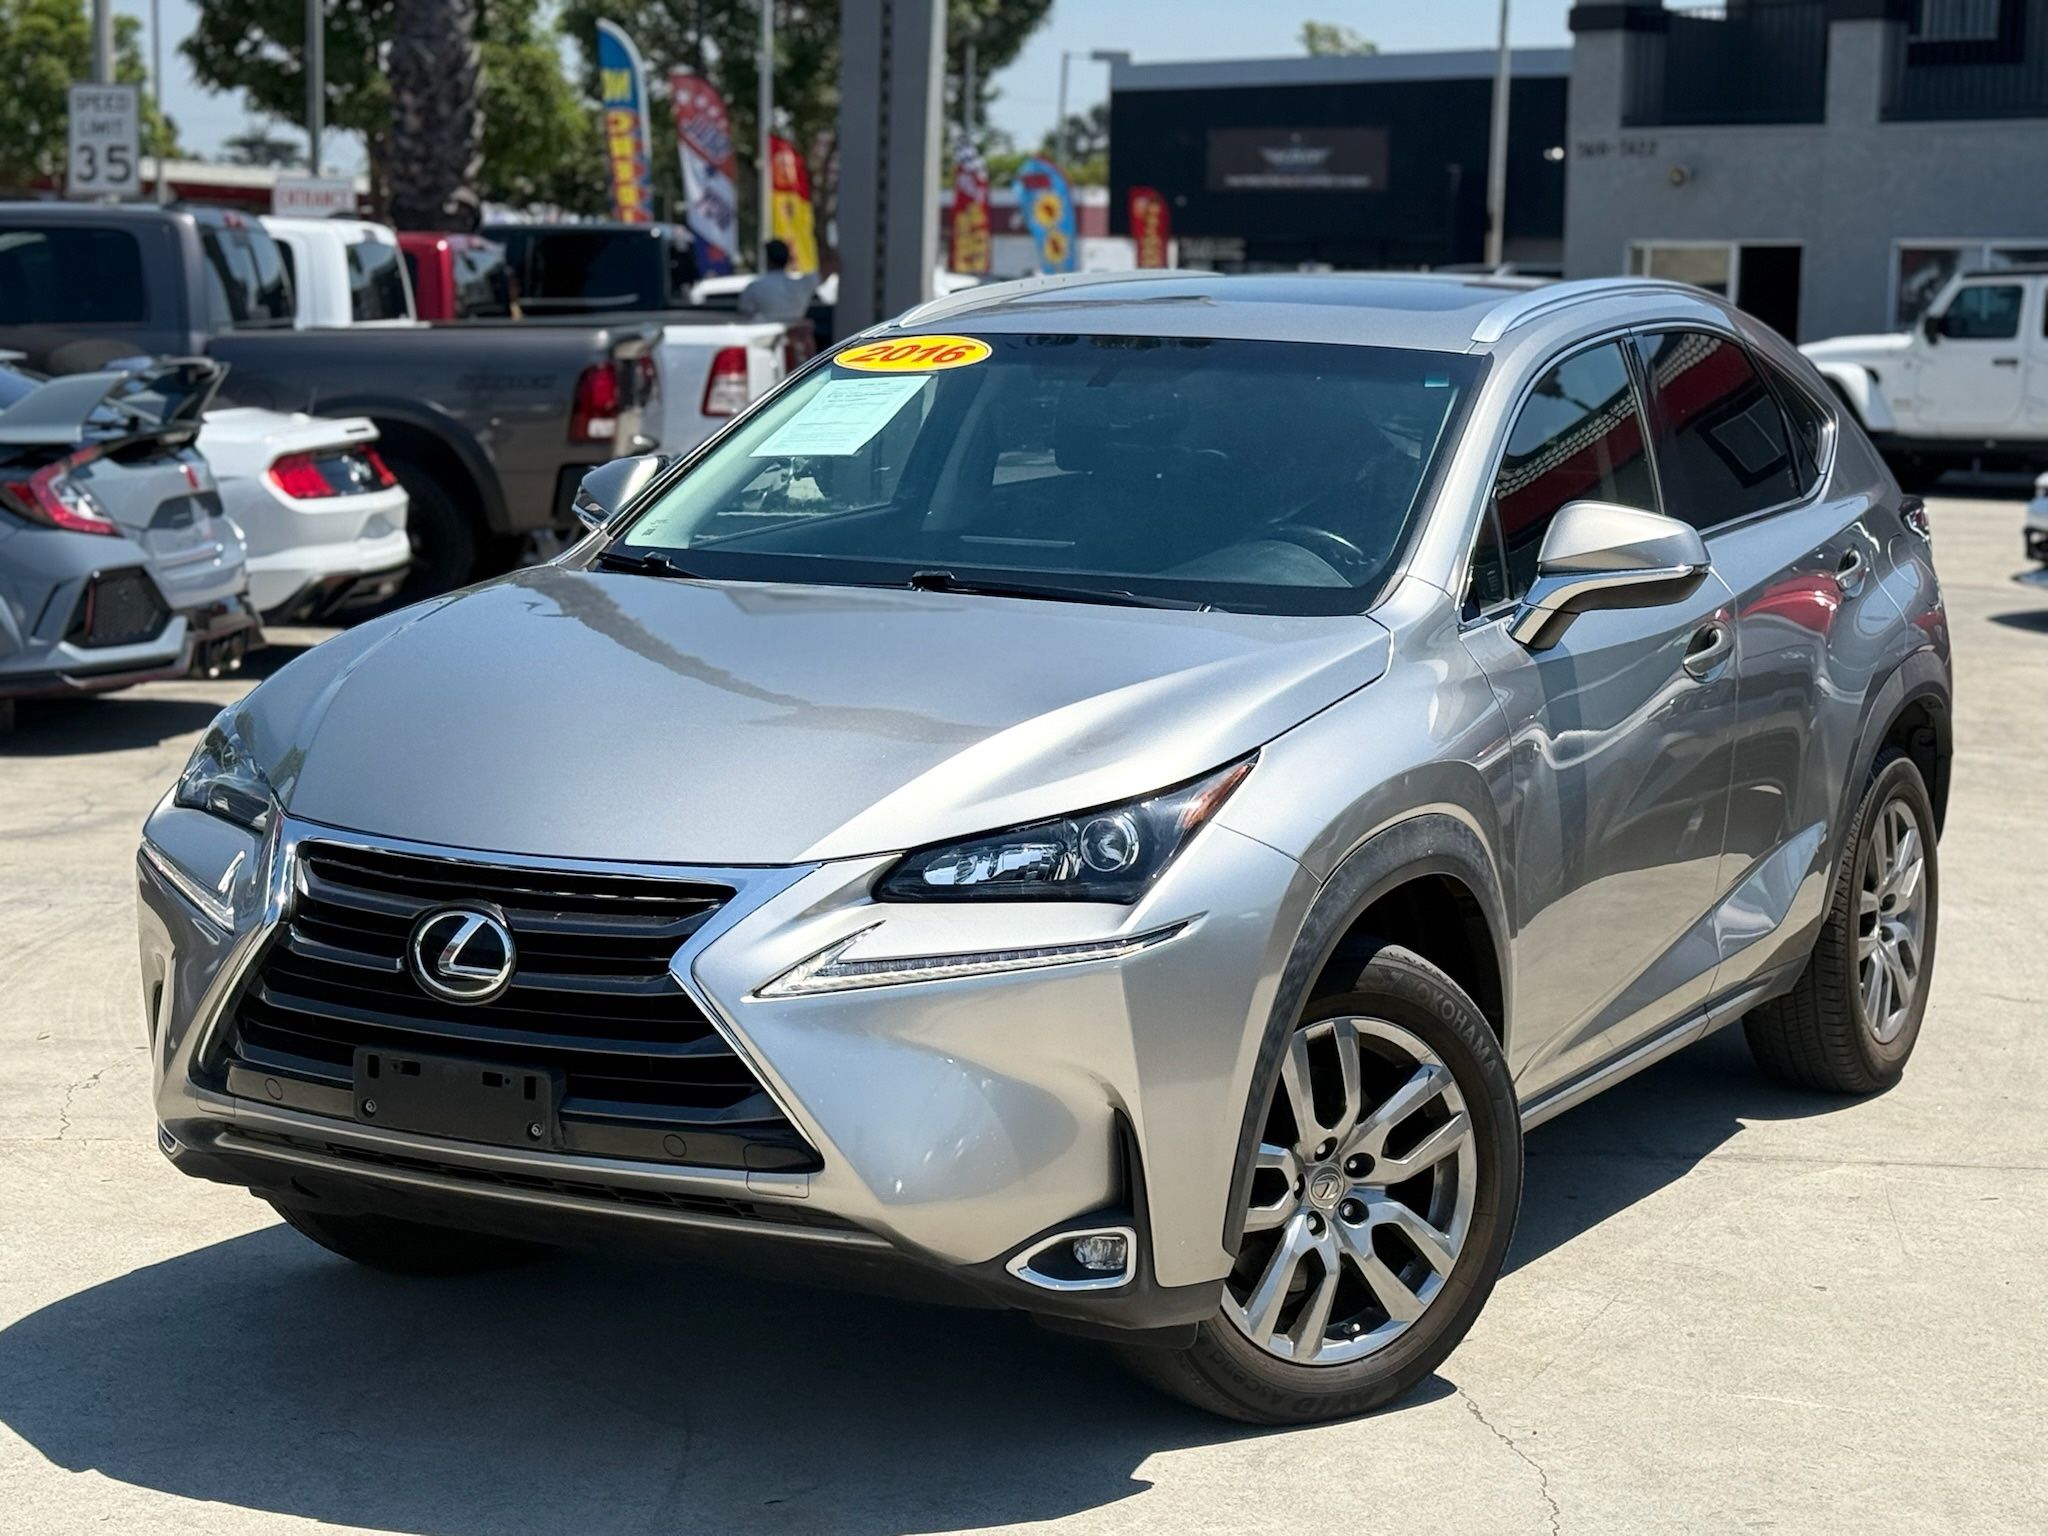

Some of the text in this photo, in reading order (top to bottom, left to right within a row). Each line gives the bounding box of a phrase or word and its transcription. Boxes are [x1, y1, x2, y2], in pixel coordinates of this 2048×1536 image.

[76, 93, 132, 113] SPEED
[78, 118, 124, 138] LIMIT
[77, 144, 133, 183] 35
[845, 344, 977, 363] 2016
